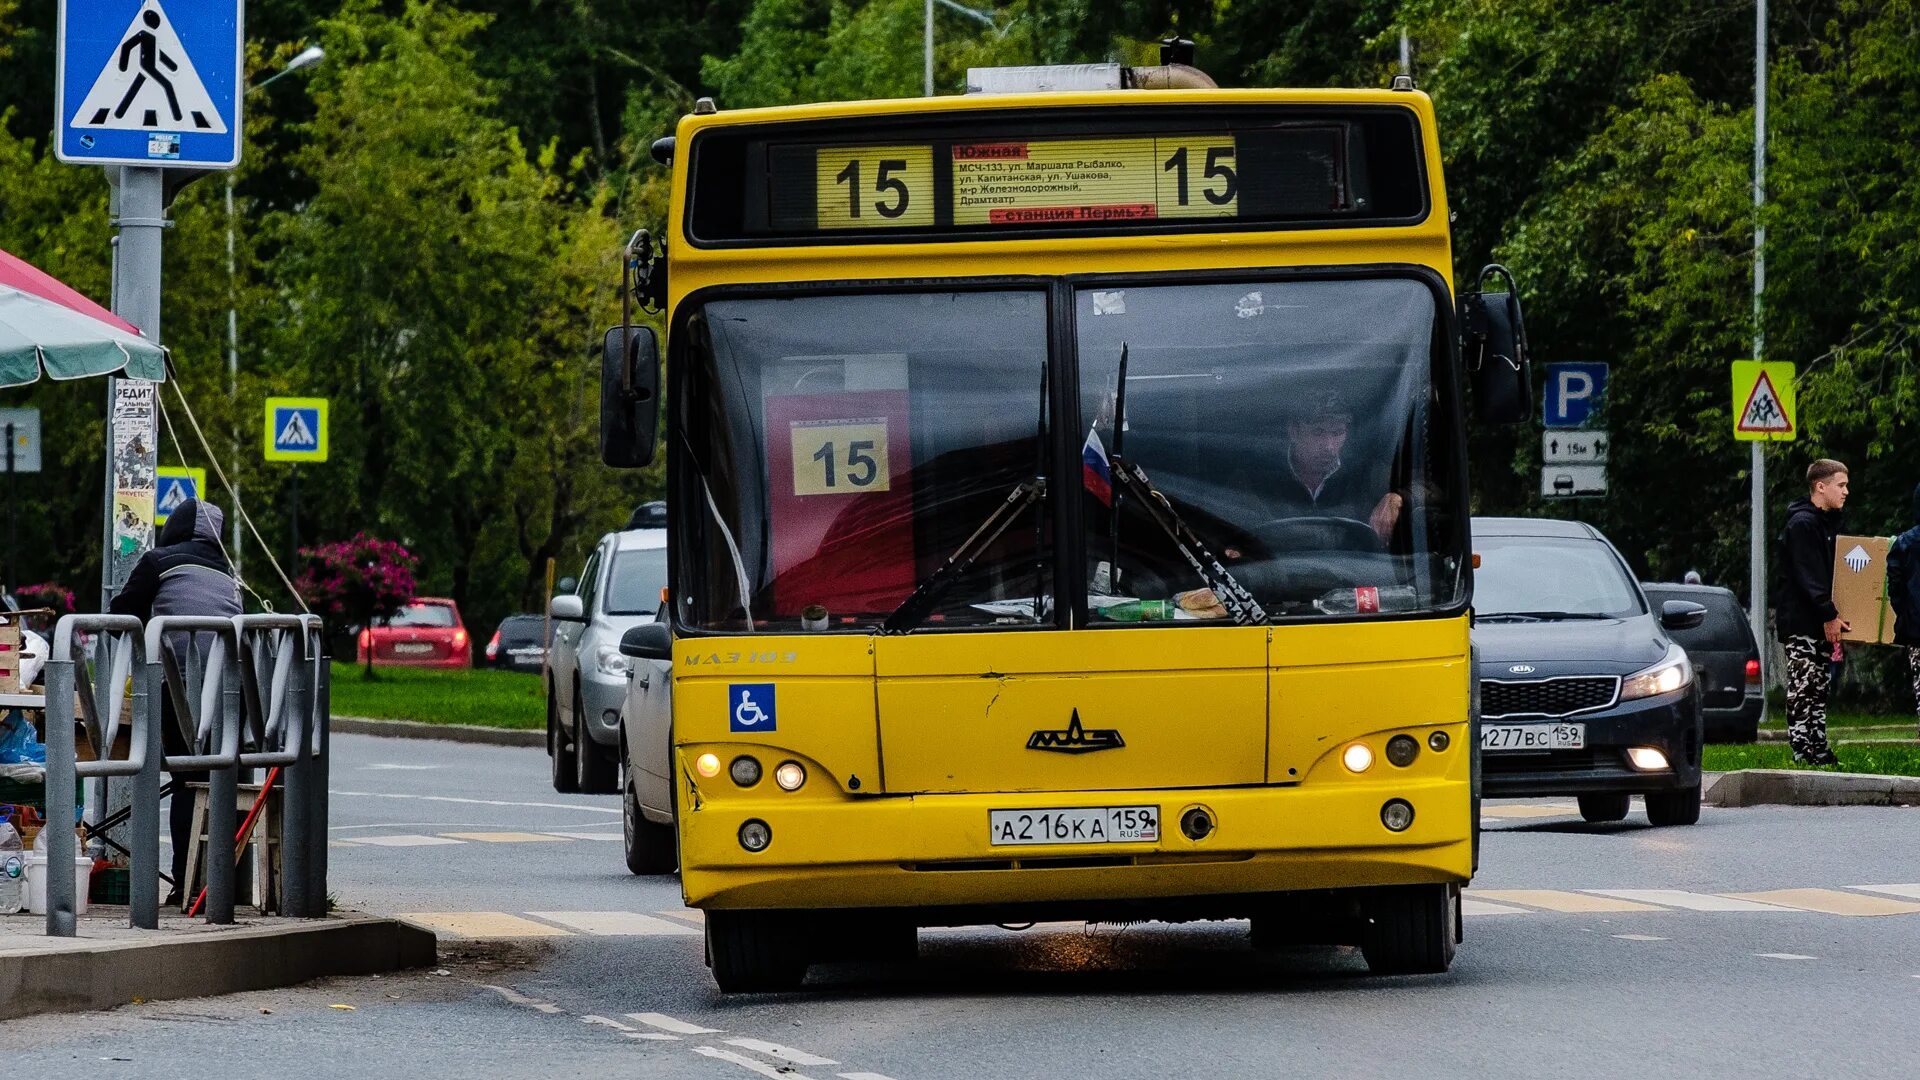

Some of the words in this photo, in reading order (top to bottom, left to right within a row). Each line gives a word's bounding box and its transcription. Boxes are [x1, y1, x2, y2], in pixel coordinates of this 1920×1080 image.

[961, 145, 1021, 158] Южная
[959, 163, 1006, 172] МСЧ-133,
[1008, 163, 1024, 172] ул.
[1026, 161, 1073, 172] Маршала
[1077, 160, 1125, 169] Рыбалко,
[960, 176, 974, 185] ул.
[977, 174, 1045, 183] Капитанская,
[1047, 173, 1062, 182] ул.
[1065, 172, 1111, 181] Ушакова,
[1165, 147, 1237, 205] 15
[837, 160, 909, 218] 15
[960, 196, 1015, 206] Драмтеатр
[1005, 210, 1074, 221] станция
[1081, 205, 1150, 219] Пермь-2
[1558, 371, 1594, 418] P
[813, 441, 877, 487] 15
[685, 652, 740, 666] МАЗ
[1511, 665, 1534, 673] KIA
[1552, 726, 1578, 740] 159
[1001, 813, 1104, 840] А216КА
[1112, 810, 1151, 829] 159
[1119, 830, 1140, 838] RUS
